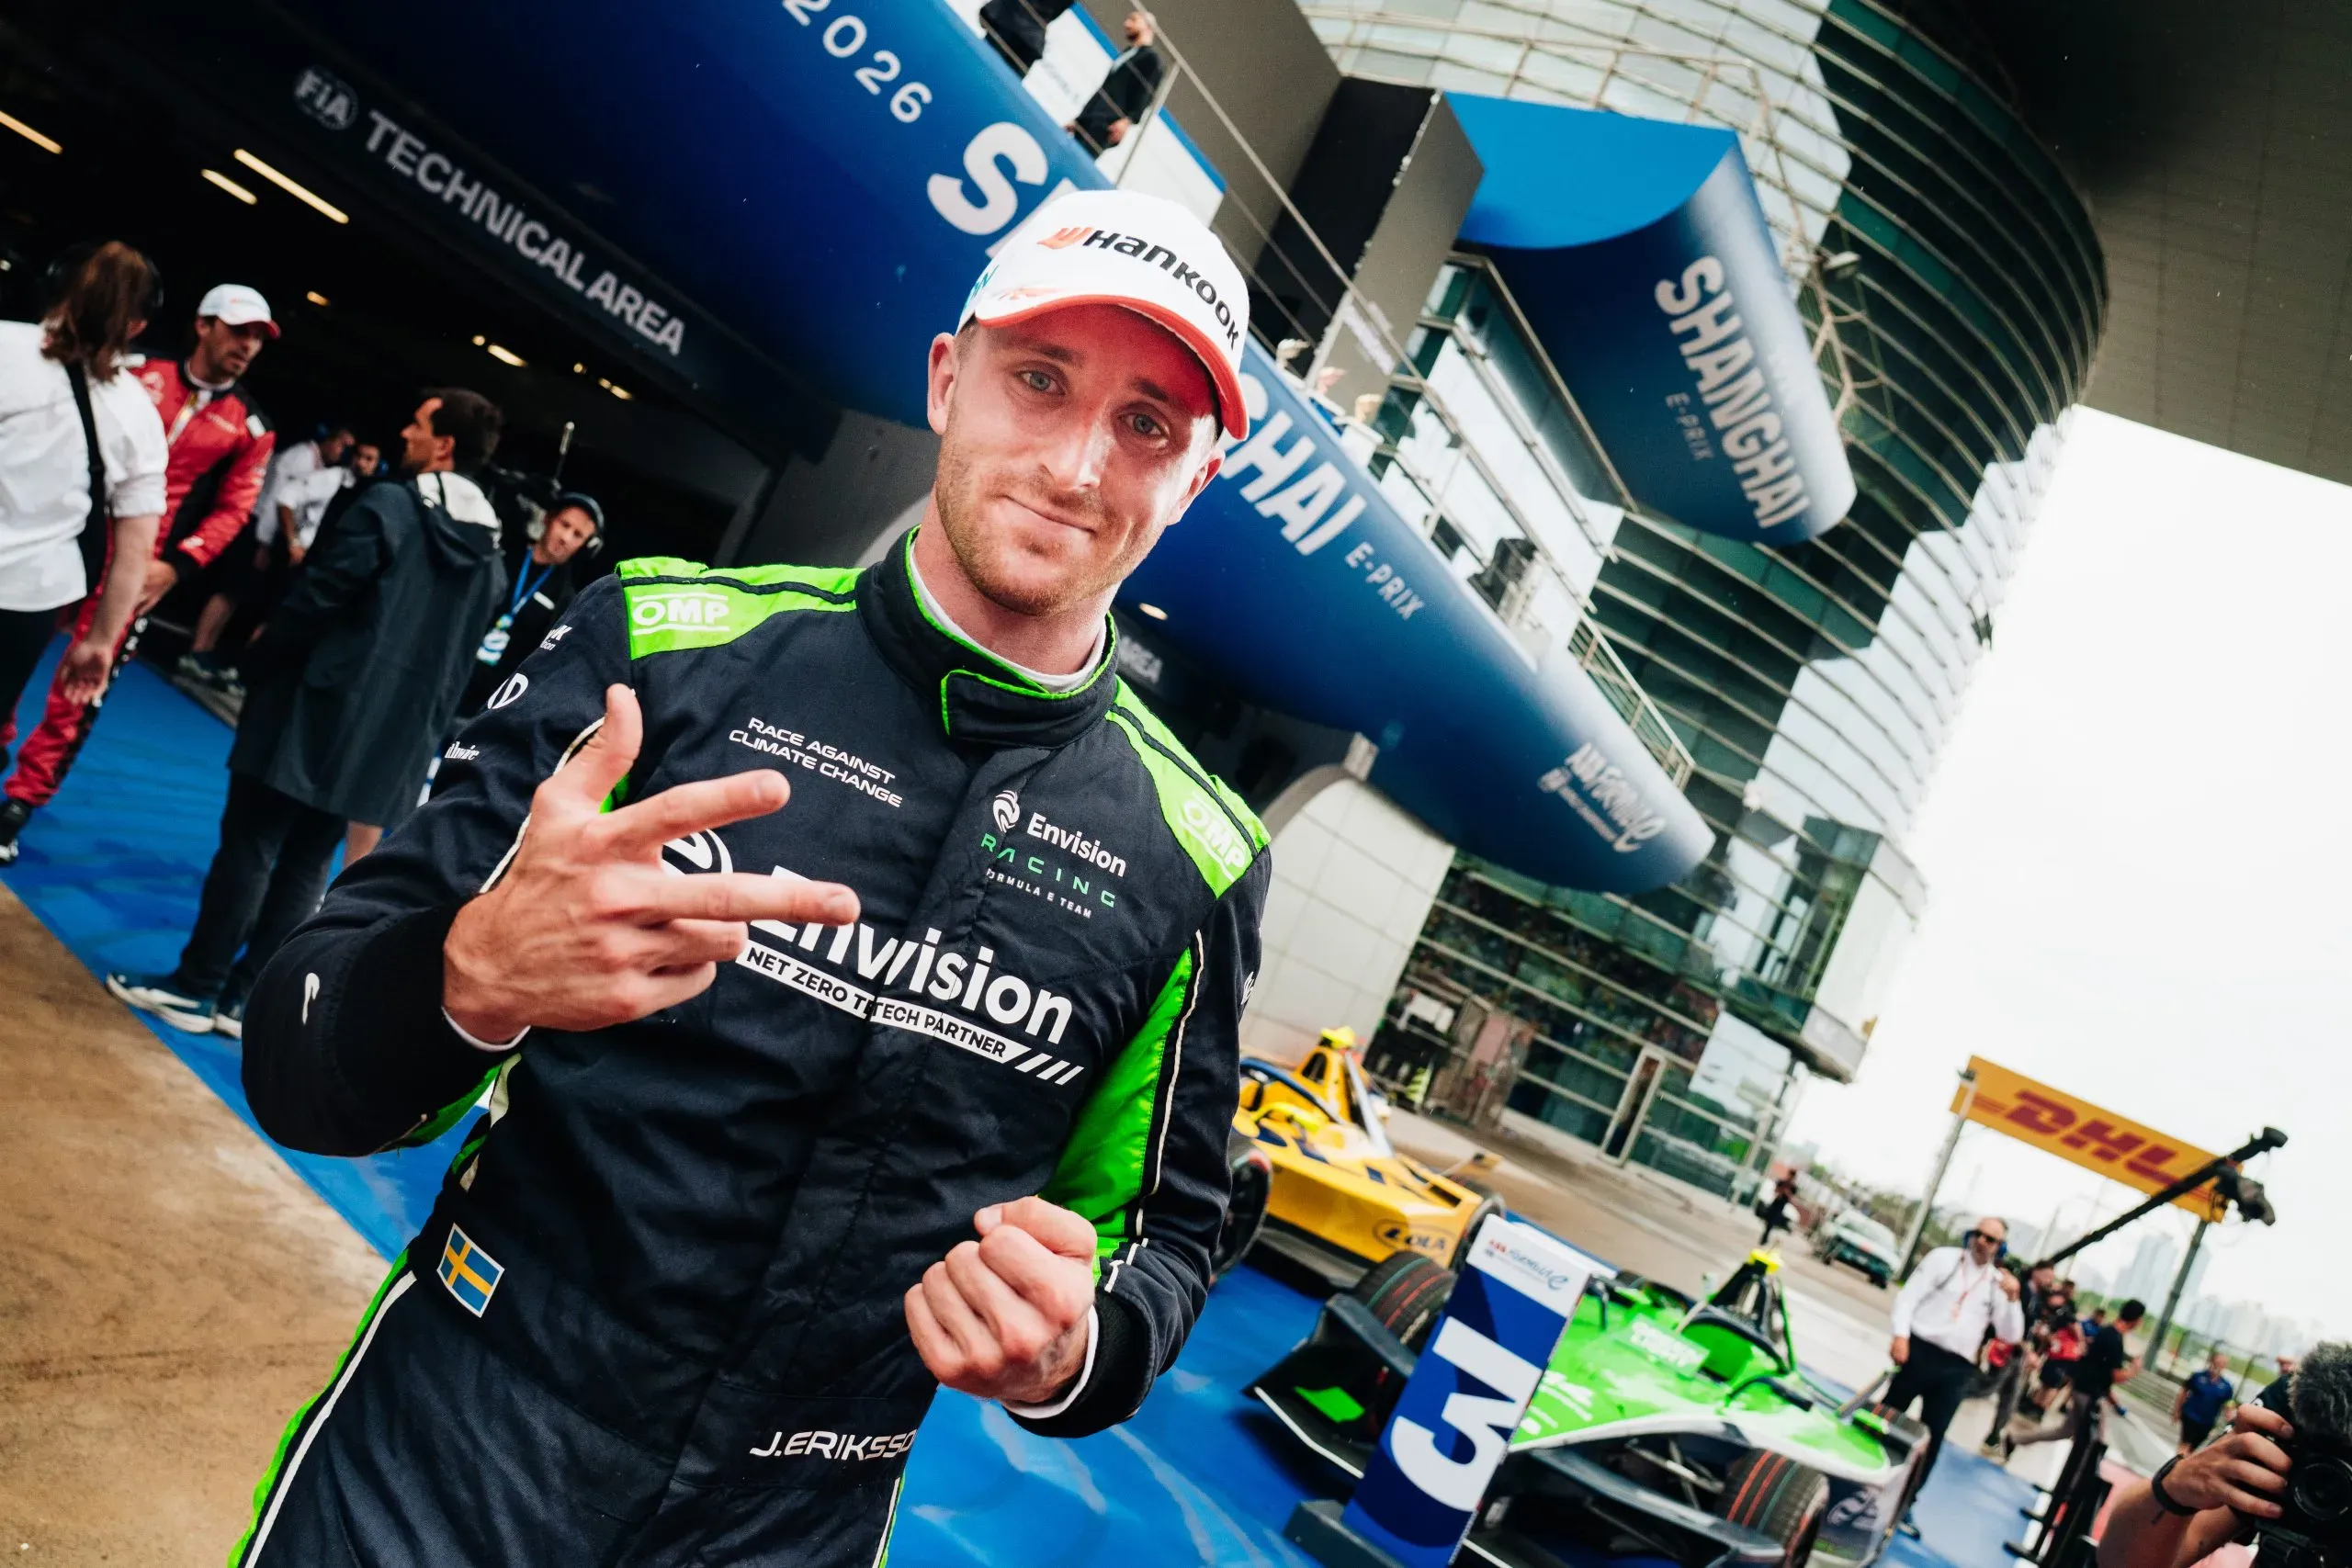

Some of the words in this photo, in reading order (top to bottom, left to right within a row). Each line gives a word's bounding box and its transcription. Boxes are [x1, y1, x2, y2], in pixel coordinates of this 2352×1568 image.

[366, 108, 585, 292] TECHNICAL
[584, 270, 685, 356] AREA
[1655, 255, 1812, 530] SHANGHAI
[632, 598, 729, 626] OMP
[1345, 541, 1425, 620] E-PRIX
[729, 729, 818, 770] CLIMATE
[819, 761, 903, 808] CHANGE
[748, 716, 805, 747] RACE
[806, 740, 896, 784] AGAINST
[980, 832, 1116, 908] RACING
[1026, 812, 1127, 878] Envision
[1182, 800, 1245, 868] OMP
[1046, 891, 1056, 903] E
[1059, 897, 1093, 919] TEAM
[746, 946, 785, 976] NET
[791, 966, 849, 1004] ZERO
[924, 1013, 1008, 1058] PARTNER
[2004, 1089, 2181, 1186] DHL
[1389, 1316, 1544, 1512] 3
